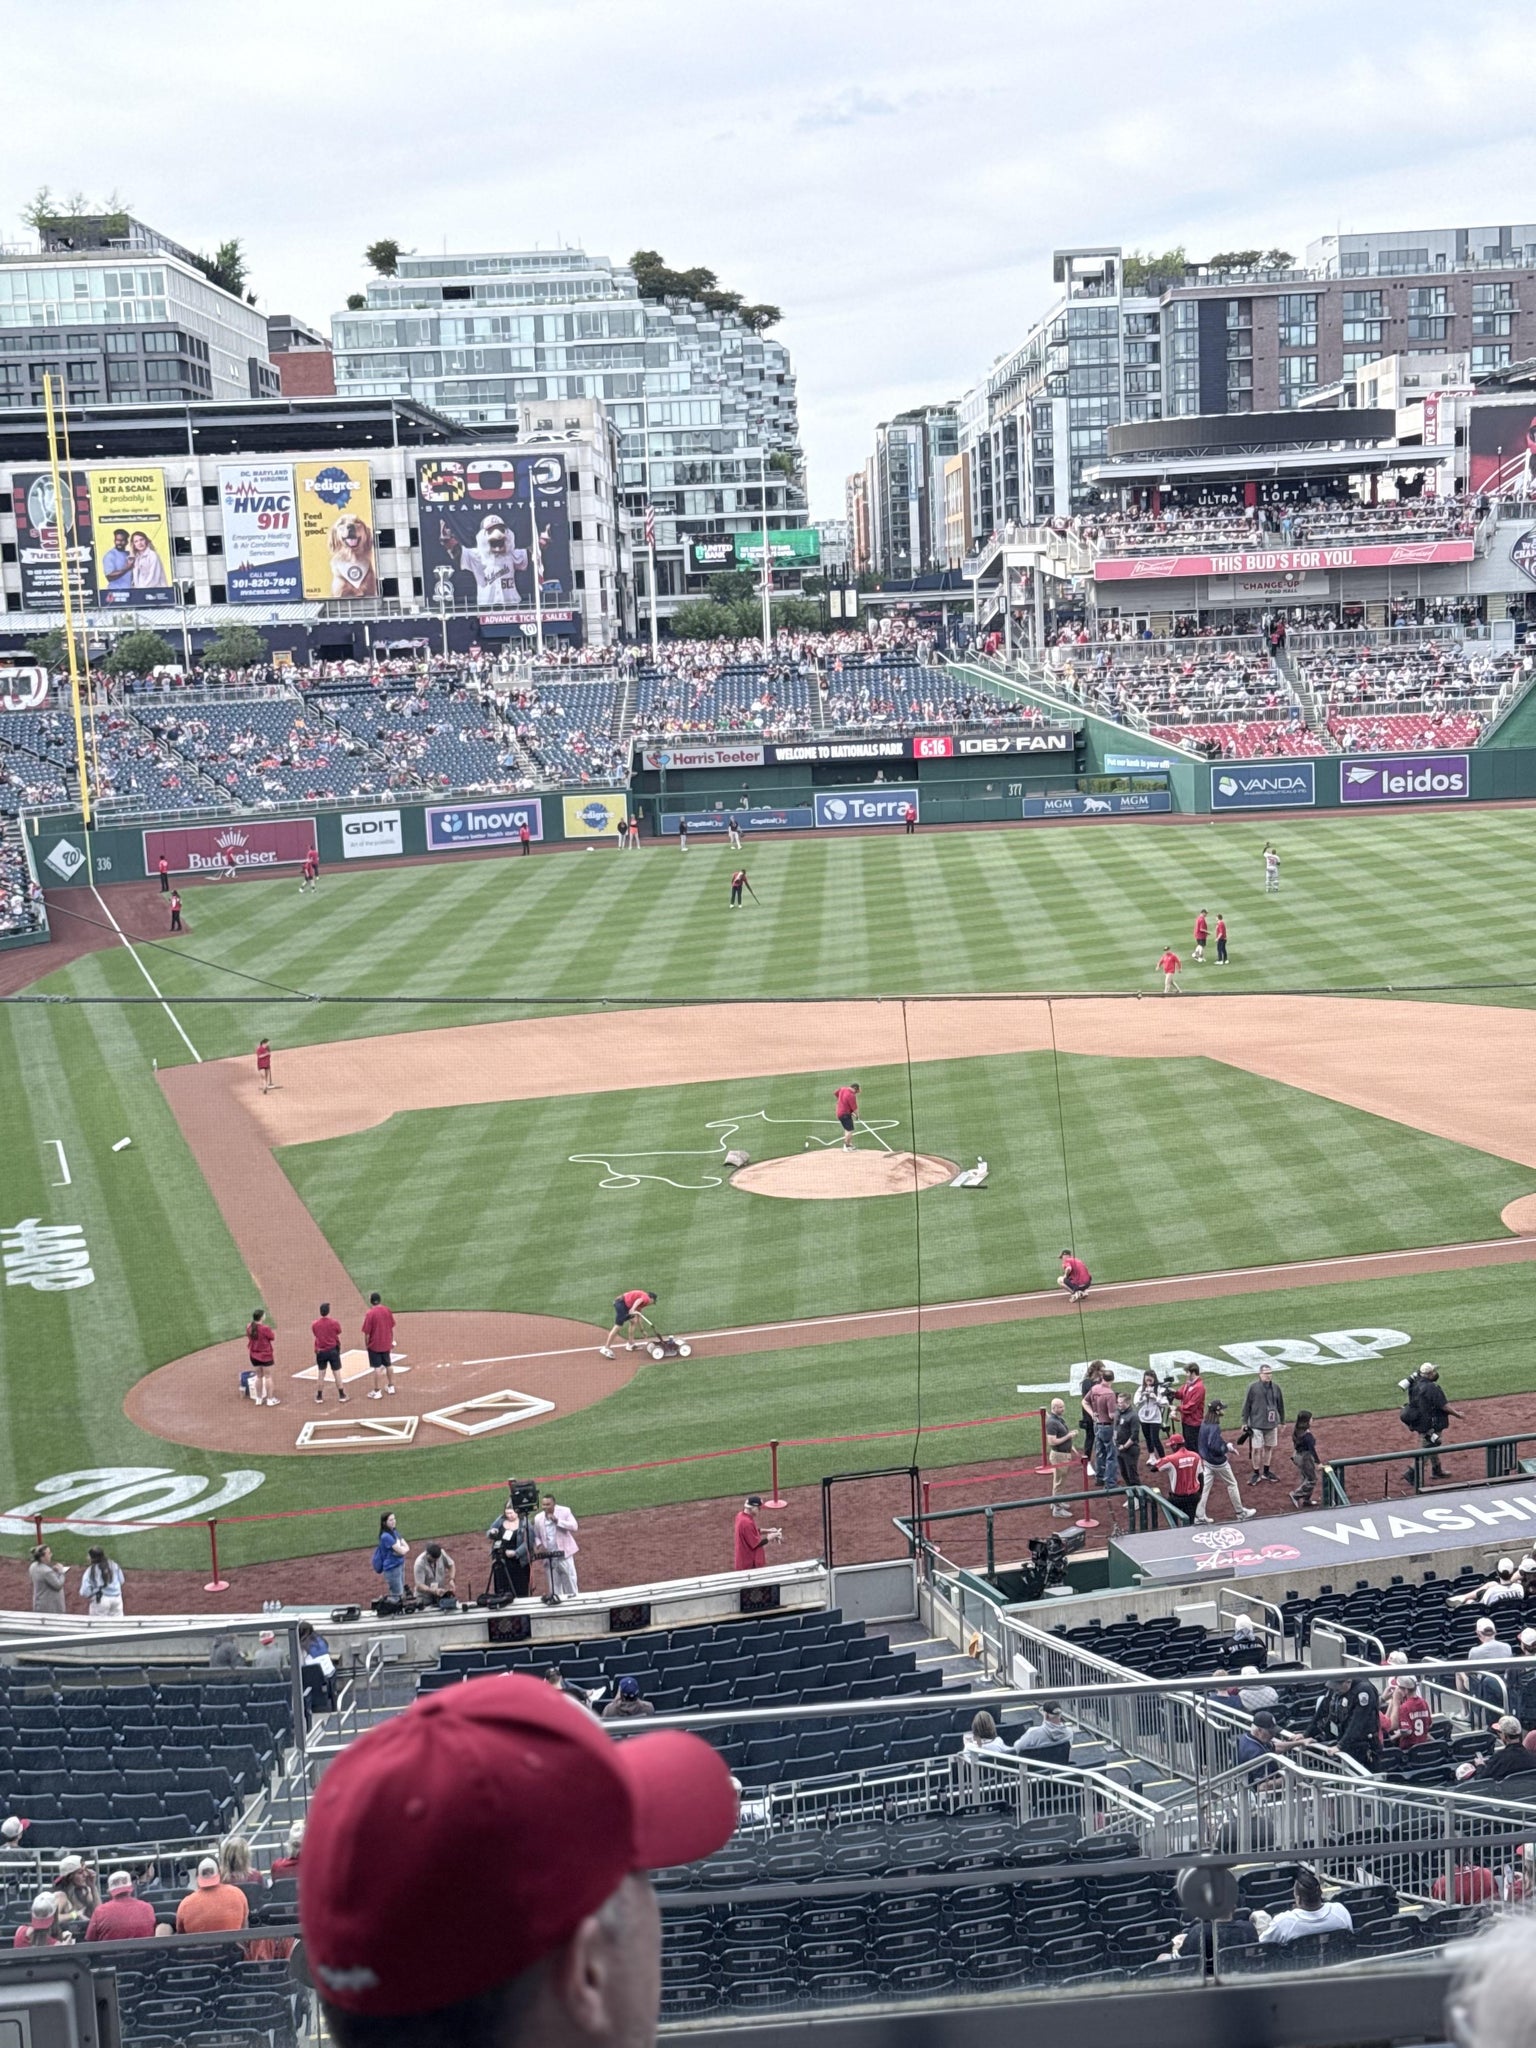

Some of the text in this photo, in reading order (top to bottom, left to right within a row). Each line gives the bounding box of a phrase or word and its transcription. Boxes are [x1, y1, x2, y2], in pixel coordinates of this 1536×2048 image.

[118, 475, 154, 483] SOUNDS
[304, 478, 361, 493] Pedigree
[110, 495, 144, 503] probably
[234, 496, 291, 513] HVAC
[1199, 491, 1299, 504] ULTRA LOFT
[257, 512, 289, 530] 911
[304, 512, 323, 520] Feed
[251, 541, 289, 549] Conditioning
[704, 544, 733, 552] UNITED
[704, 551, 726, 559] BANK
[1210, 550, 1357, 572] THIS BUD'S FOR YOU.
[1243, 580, 1299, 590] CHANGE-UP
[485, 612, 568, 623] ADVANCE TICKT SALES
[920, 739, 945, 755] 6:16
[1016, 735, 1066, 751] FAN
[673, 750, 760, 765] Harris Teeter
[776, 743, 903, 760] WELCOME TO NATIONALS PARK
[1239, 777, 1306, 791] VANDA
[1382, 768, 1463, 793] leidos
[1008, 783, 1022, 796] 377
[849, 799, 909, 818] Terra
[1045, 800, 1072, 809] MGM
[1120, 796, 1148, 806] MGM
[467, 811, 528, 831] Inova
[576, 811, 615, 821] Pedigree
[345, 819, 398, 835] GDIT
[452, 833, 469, 841] Where
[96, 857, 112, 872] 336
[1017, 1328, 1411, 1396] AARP
[1196, 1549, 1300, 1571] America
[1414, 1719, 1424, 1736] 9
